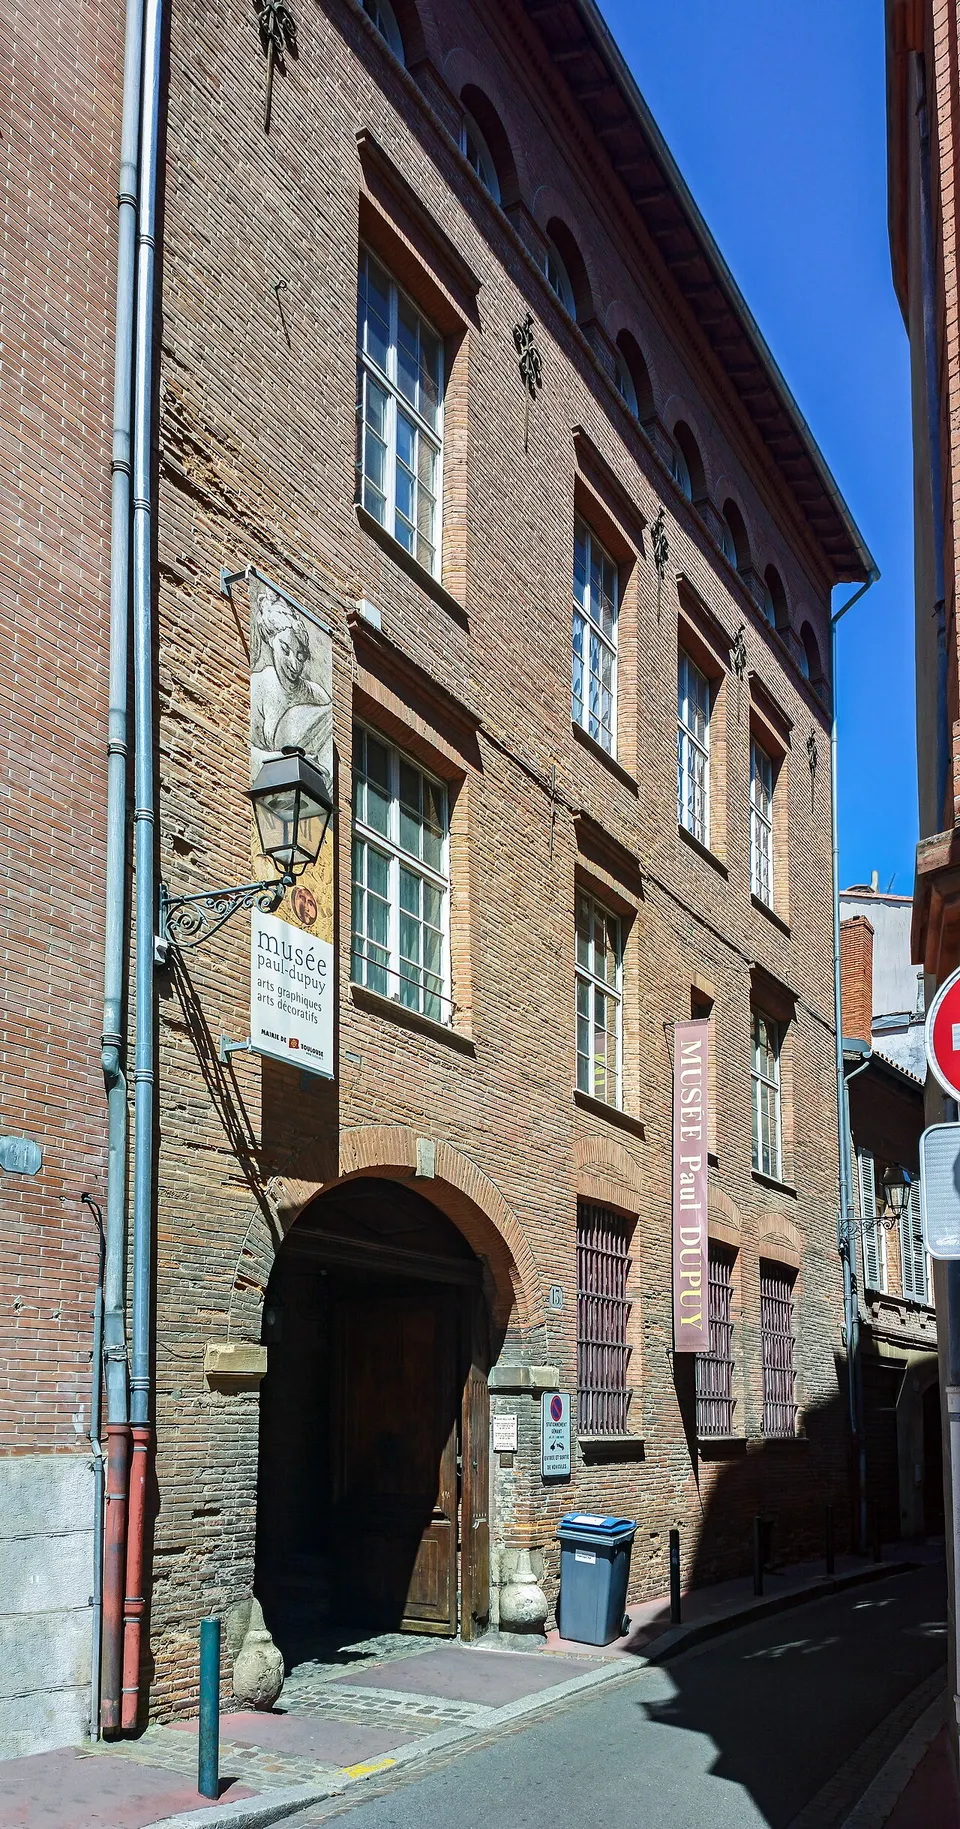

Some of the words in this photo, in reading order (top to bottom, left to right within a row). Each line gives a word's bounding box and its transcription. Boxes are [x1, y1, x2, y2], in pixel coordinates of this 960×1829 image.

[257, 930, 327, 977] musée
[257, 953, 326, 996] paul-dupuy
[257, 977, 275, 992] arts
[277, 986, 322, 1012] graphiques
[257, 992, 275, 1007] arts
[277, 999, 318, 1025] décoratifs
[260, 1028, 280, 1041] MAIRIE
[300, 1043, 324, 1058] TOULOUSE
[680, 1040, 705, 1143] MUSÉE
[679, 1154, 702, 1212] Paul
[679, 1225, 703, 1331] DUPUY
